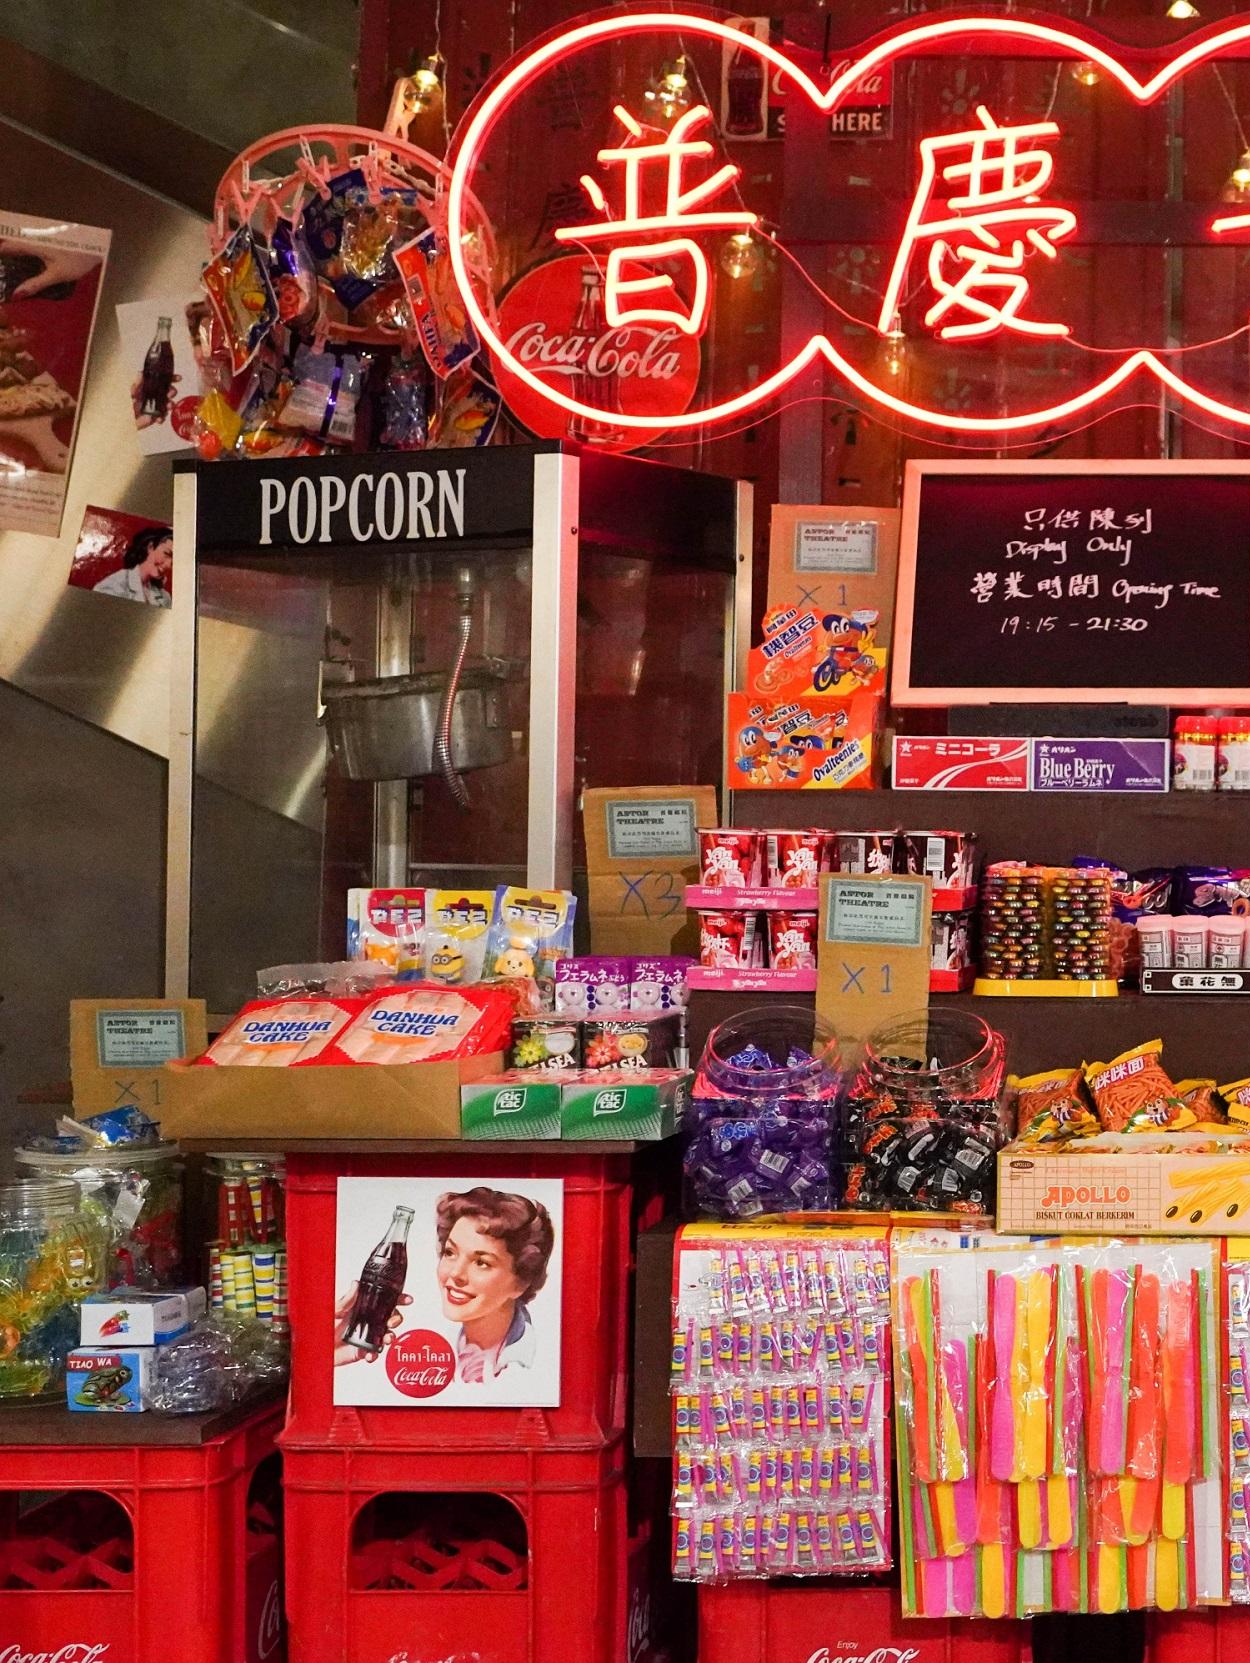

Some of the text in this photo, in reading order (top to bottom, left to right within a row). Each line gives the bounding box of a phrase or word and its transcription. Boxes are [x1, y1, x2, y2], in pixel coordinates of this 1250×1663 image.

[832, 112, 883, 132] HERE
[502, 322, 685, 379] Coca-Cola
[259, 469, 466, 545] POPCORN
[1023, 508, 1153, 534] 只供陳列
[1005, 536, 1133, 566] Display Only
[969, 571, 1222, 609] 營業時間 Opening Time
[1000, 614, 1059, 635] 19:15
[1086, 617, 1149, 633] 21:30
[935, 742, 1001, 757] ミニコーラ
[812, 739, 861, 782] Ovalteenies
[1040, 757, 1115, 785] Blue Berry
[702, 887, 796, 897] meiji Strawberry Flavour
[839, 890, 874, 899] ASTOR
[839, 899, 889, 908] THEATRE
[703, 969, 724, 978] meiji
[738, 970, 773, 978] Strawberry
[371, 1010, 460, 1026] DANHUA
[243, 1020, 333, 1033] DANHUA
[377, 1022, 438, 1036] CAKE
[249, 1031, 309, 1043] CAKE
[1094, 1056, 1146, 1091] 咪咪面
[503, 1092, 522, 1101] tic
[603, 1092, 622, 1101] tic
[500, 1099, 521, 1109] tac
[600, 1099, 621, 1109] tac
[1041, 1185, 1131, 1208] APOLLO
[1036, 1210, 1135, 1220] BISKUT COKLAT BERKERIM
[69, 1357, 112, 1370] TIAO WA
[393, 1365, 449, 1386] Coca-Cola
[836, 1641, 858, 1650] Enjoy
